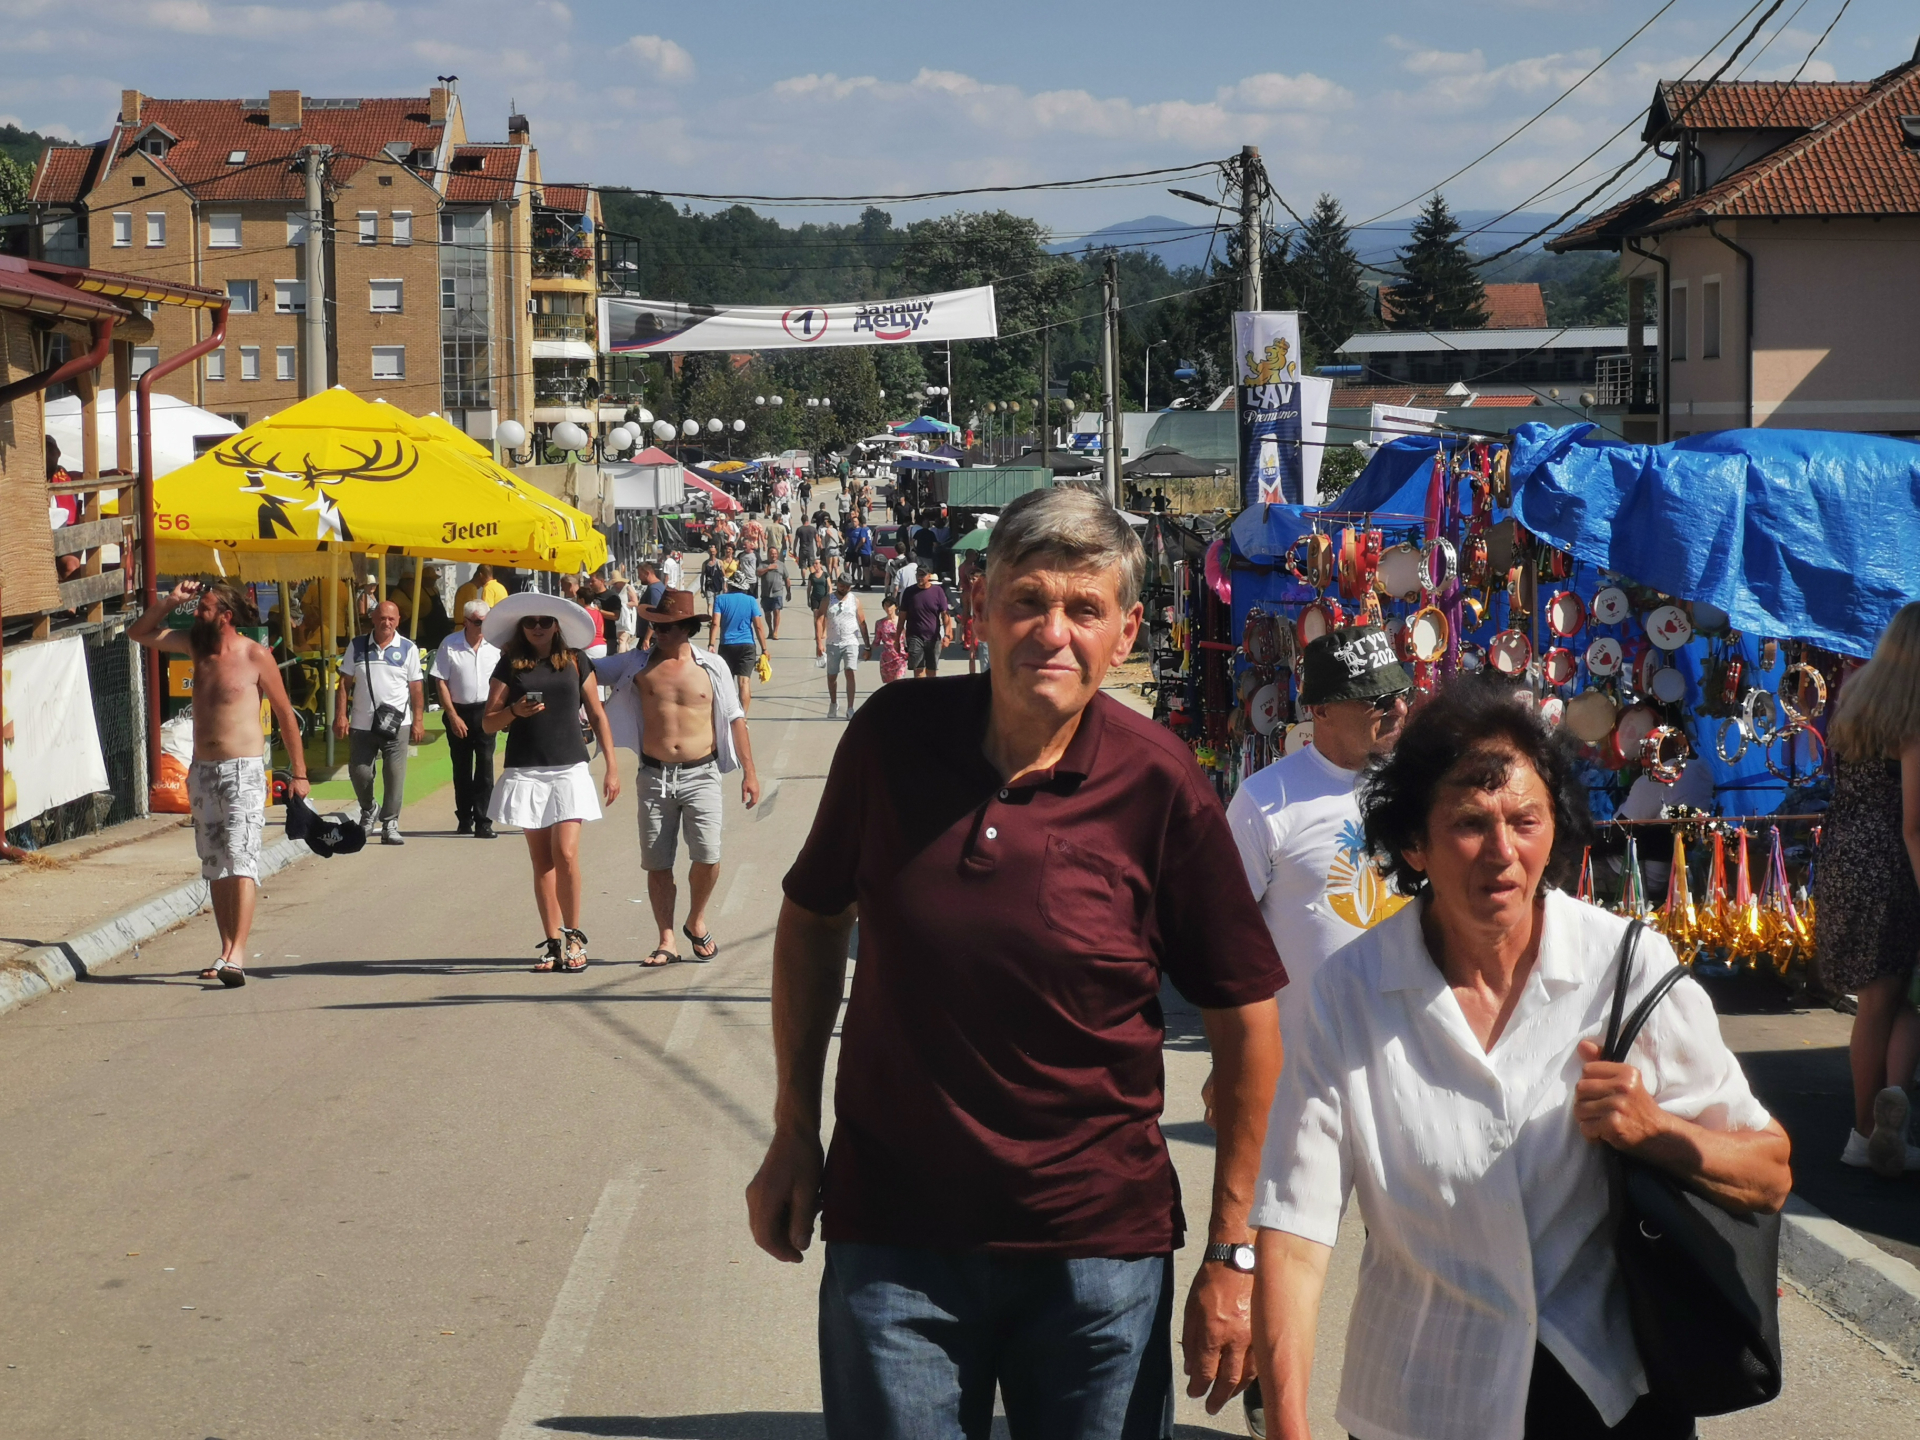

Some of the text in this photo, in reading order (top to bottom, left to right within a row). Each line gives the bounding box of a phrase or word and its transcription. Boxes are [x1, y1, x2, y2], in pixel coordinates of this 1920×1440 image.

[1246, 383, 1293, 409] LAV
[1243, 409, 1299, 425] Premium
[441, 521, 499, 544] Jelen
